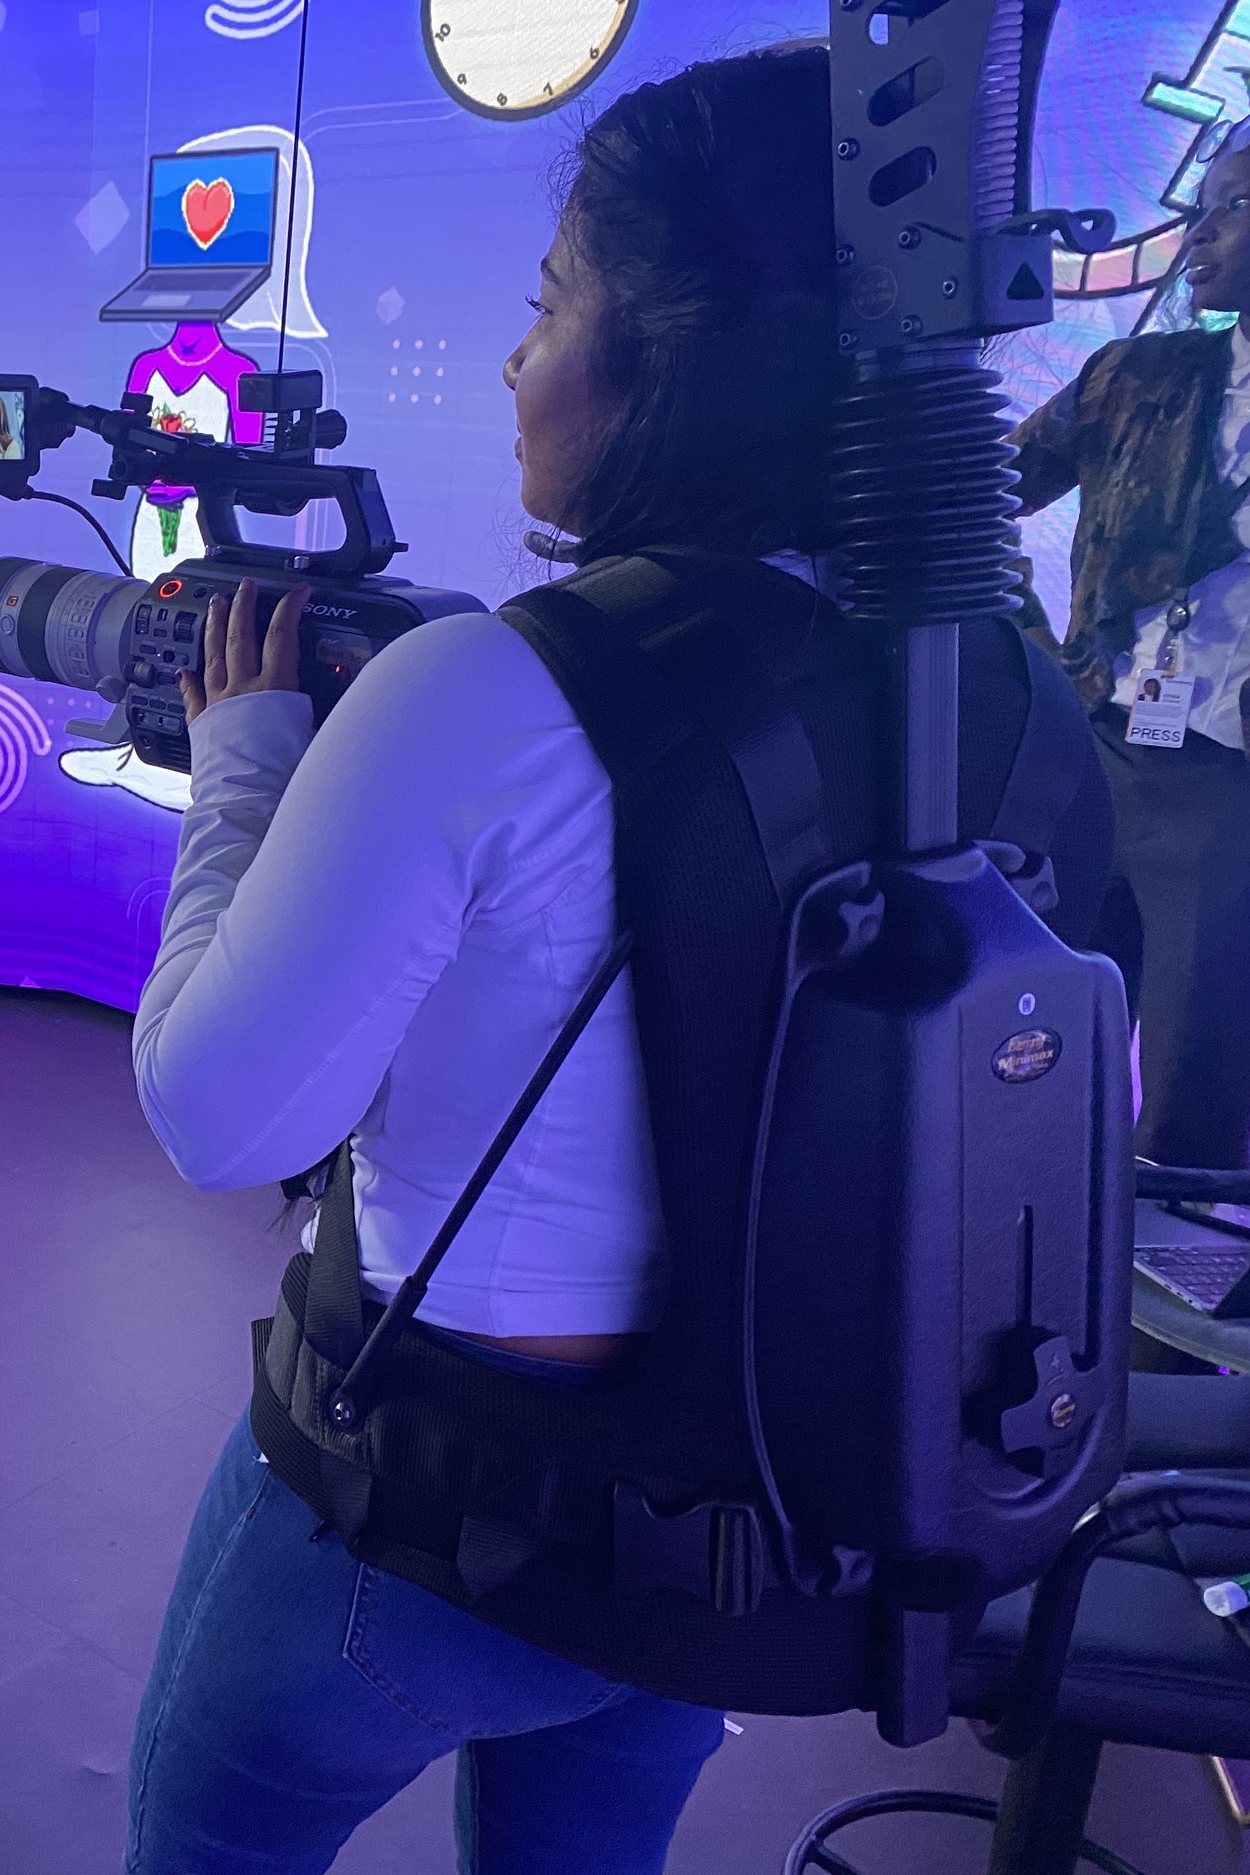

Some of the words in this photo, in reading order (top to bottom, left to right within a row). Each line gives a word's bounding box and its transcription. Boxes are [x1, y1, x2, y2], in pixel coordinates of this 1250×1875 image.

[434, 23, 451, 42] 10
[589, 47, 599, 59] 6
[457, 73, 467, 85] 9
[543, 82, 554, 96] 7
[497, 92, 507, 106] 8
[303, 603, 358, 619] SONY
[1130, 727, 1181, 742] PRESS
